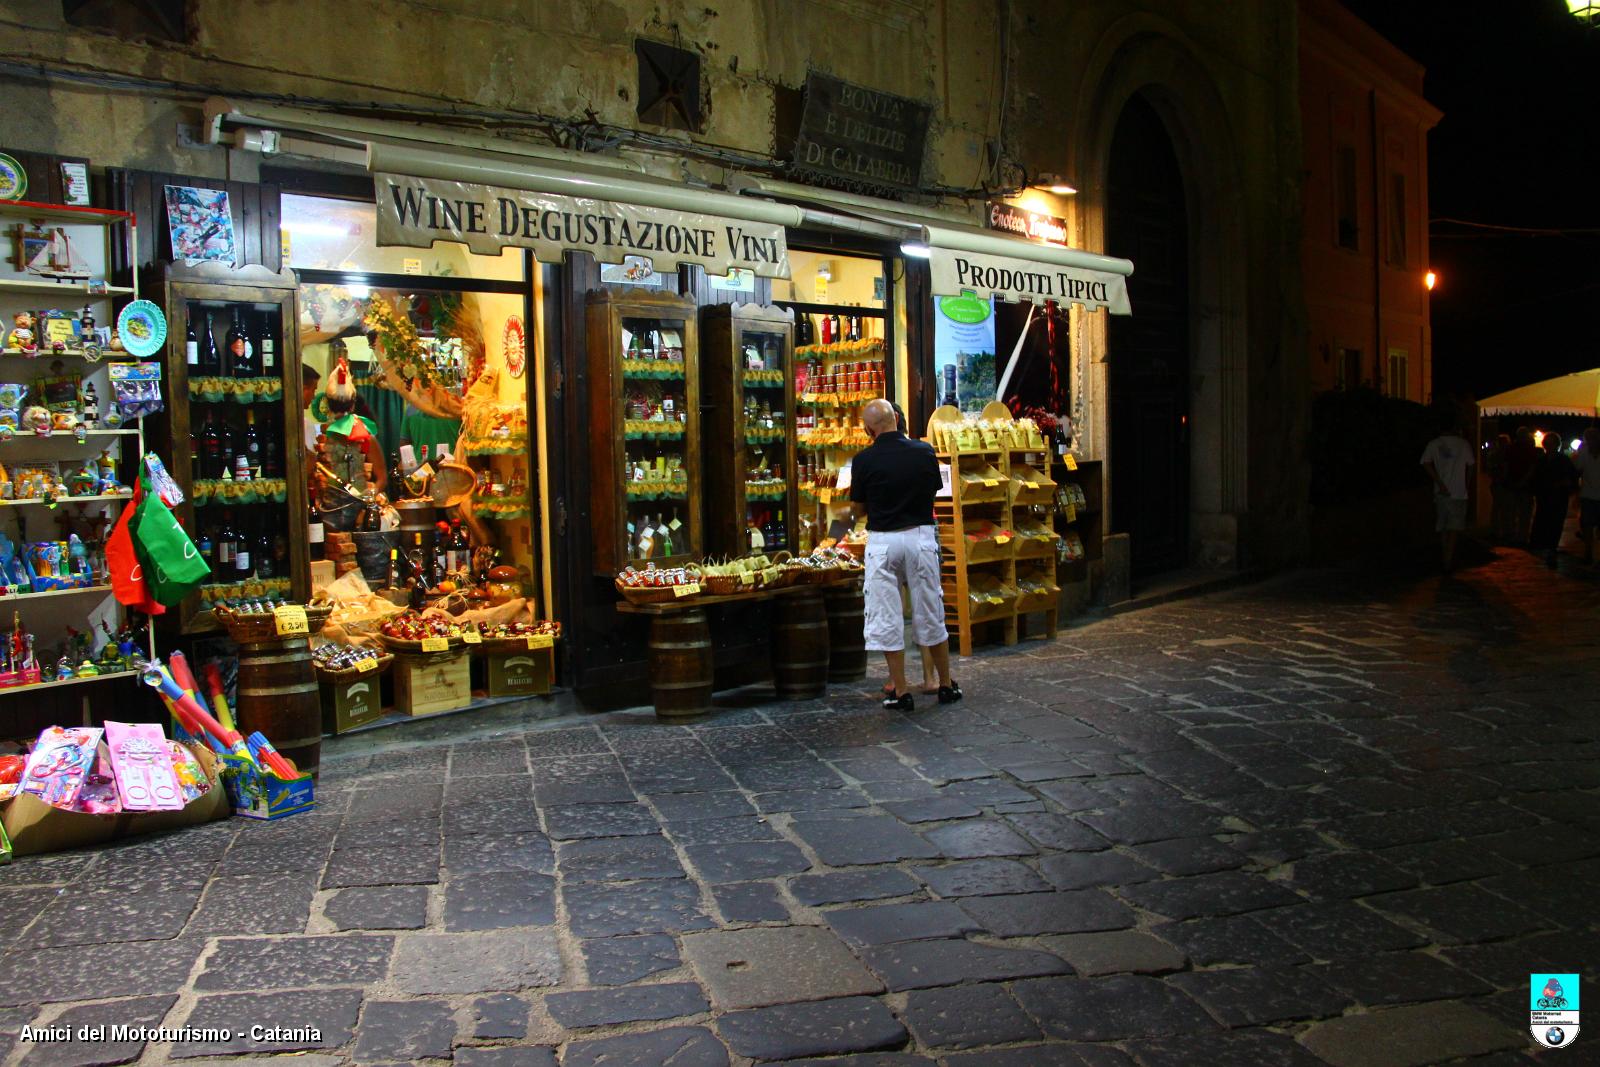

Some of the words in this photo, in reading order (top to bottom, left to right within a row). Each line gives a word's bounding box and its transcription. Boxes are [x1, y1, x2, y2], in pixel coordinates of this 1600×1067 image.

[825, 111, 836, 134] E
[844, 117, 906, 152] DELIZIE
[805, 142, 827, 165] DI
[832, 147, 912, 185] CALABRIA
[389, 184, 487, 234] WINE
[498, 197, 716, 258] DEGUSTAZIONE
[726, 226, 780, 264] VINI
[991, 205, 1029, 239] Enoteca
[955, 258, 1053, 295] PRODOTTI
[1057, 273, 1109, 302] TIPICI
